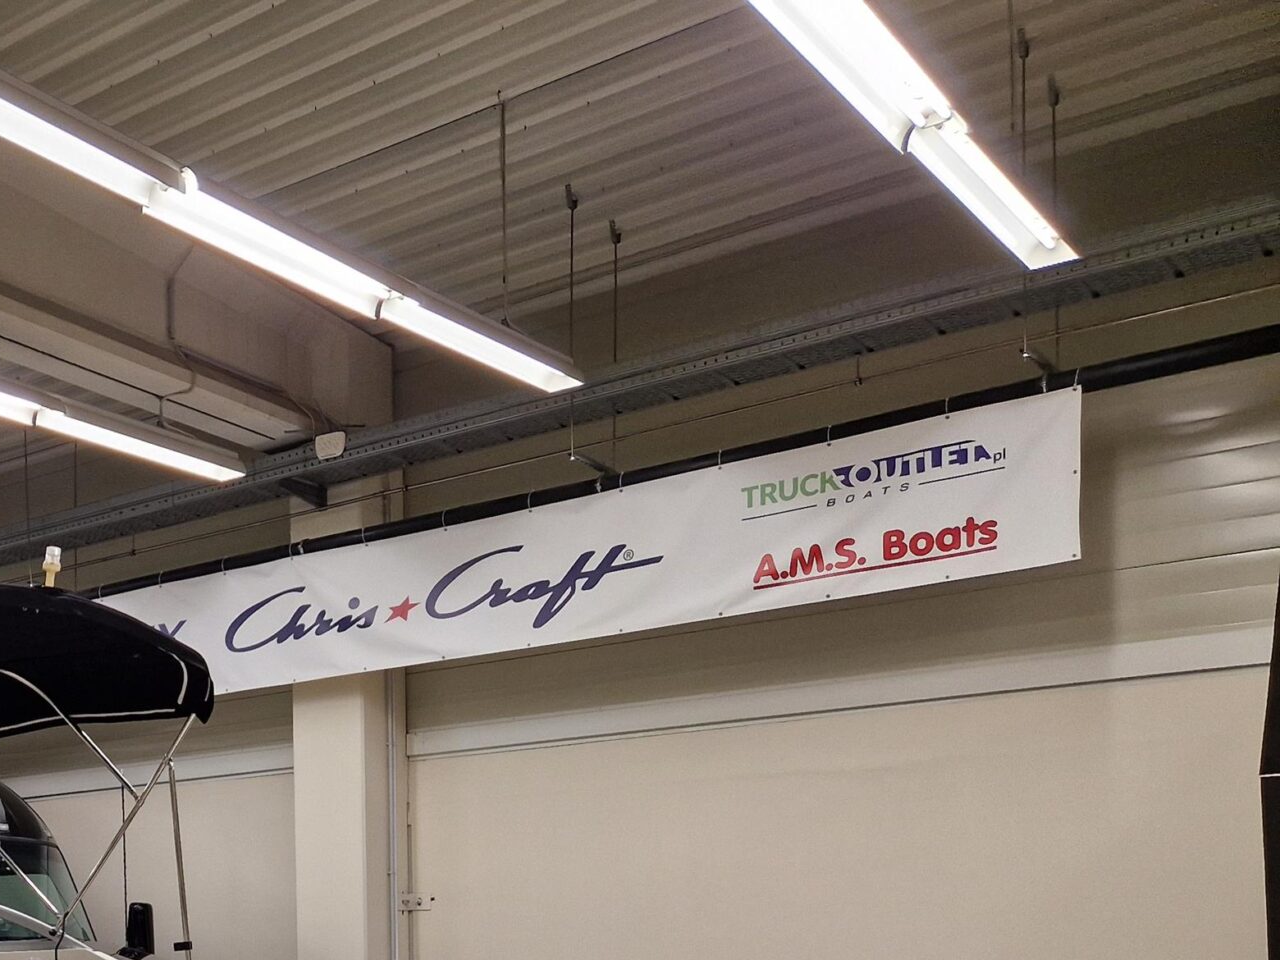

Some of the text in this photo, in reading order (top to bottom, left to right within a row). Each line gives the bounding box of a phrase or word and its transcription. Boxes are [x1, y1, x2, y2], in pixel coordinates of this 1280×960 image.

[826, 482, 910, 508] BOATS
[753, 516, 998, 584] A.M.S. Boats
[224, 586, 379, 653] Chris
